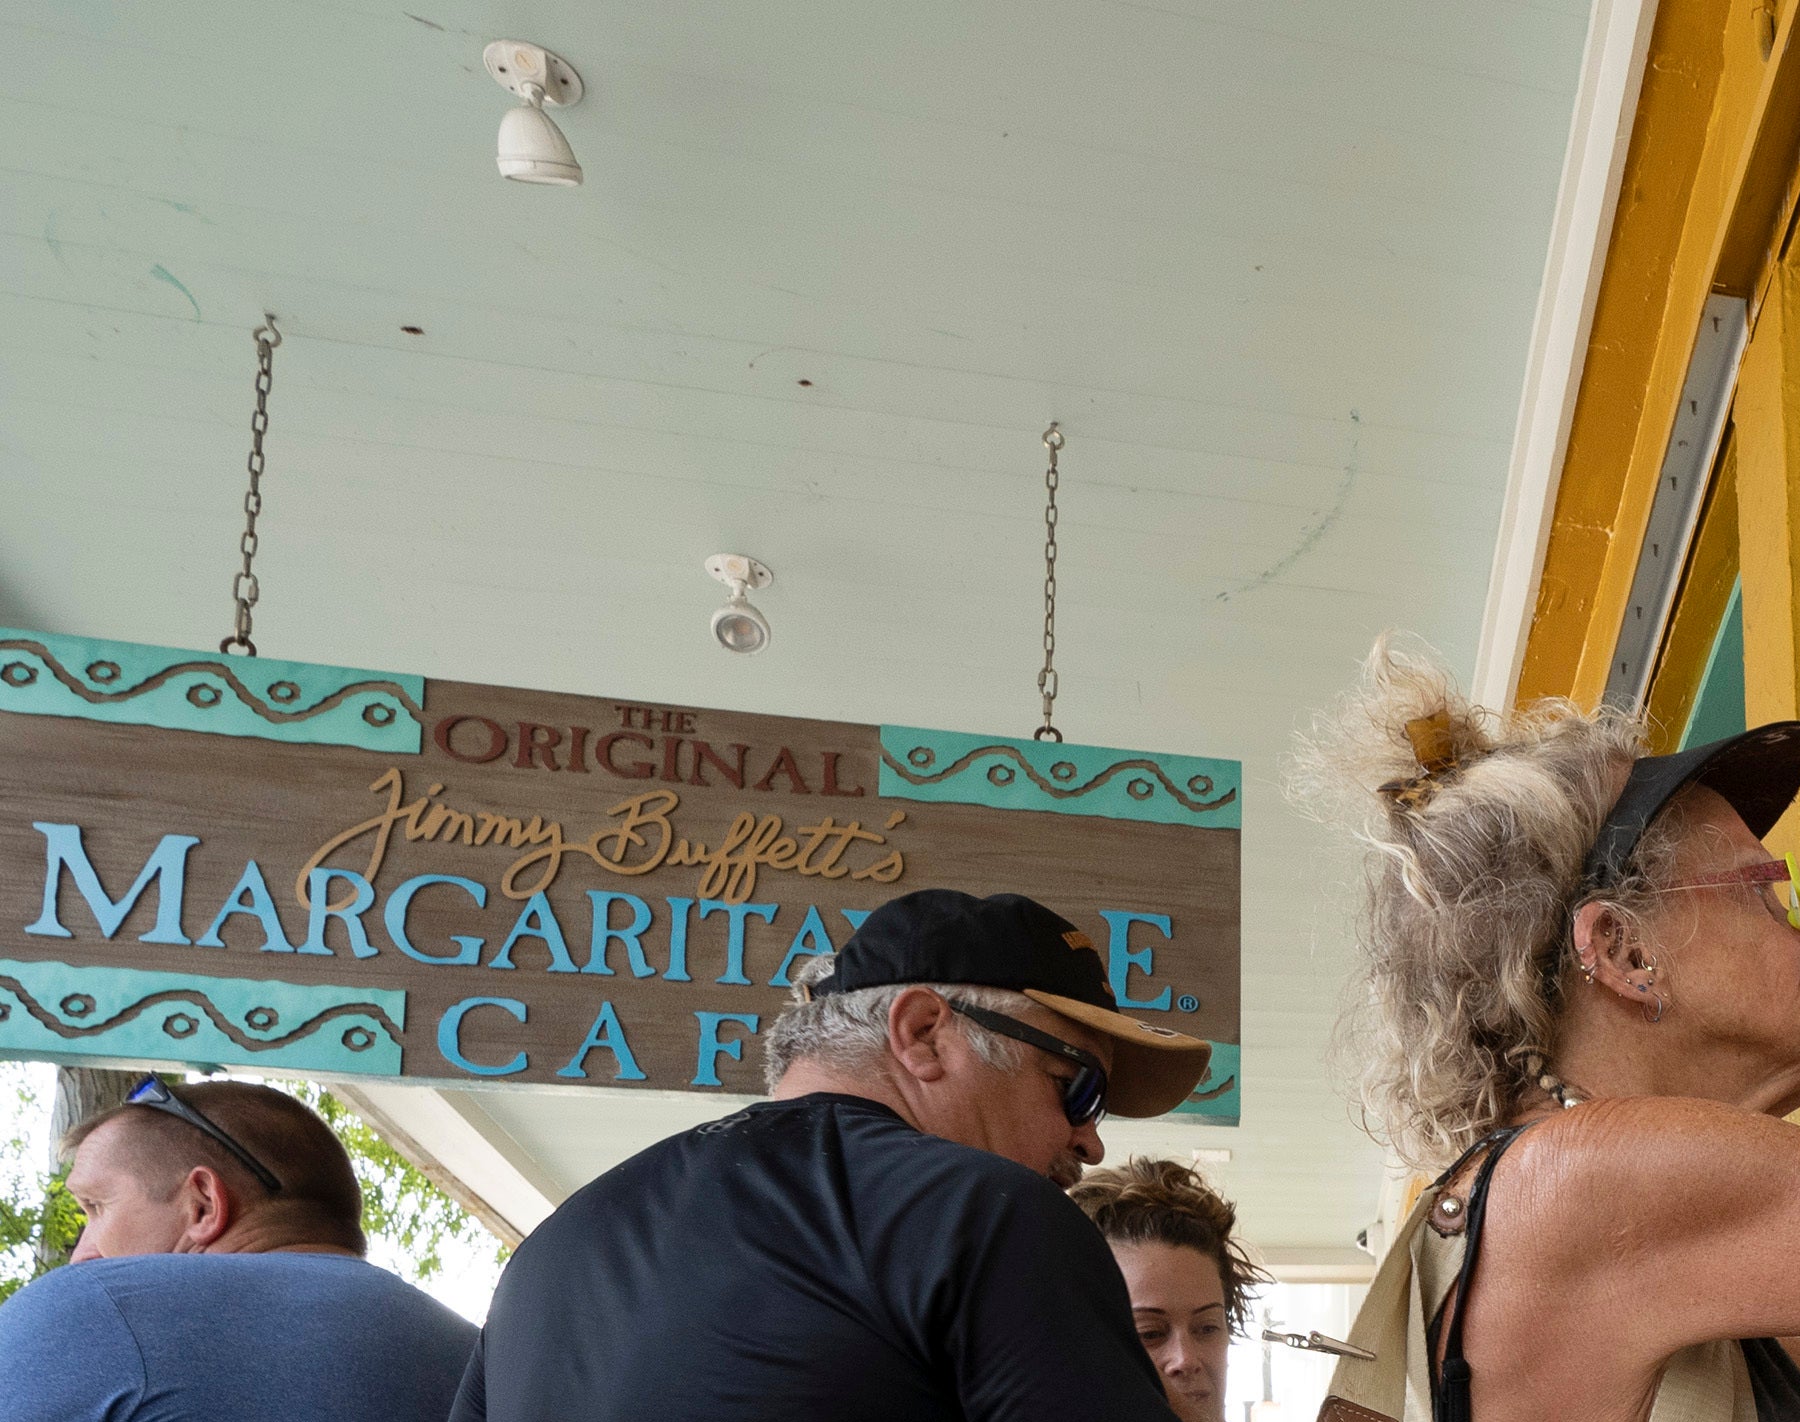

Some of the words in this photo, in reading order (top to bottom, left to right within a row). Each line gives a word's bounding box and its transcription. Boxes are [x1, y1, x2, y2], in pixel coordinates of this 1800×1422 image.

[433, 714, 865, 797] ORIGINAL
[614, 704, 698, 734] THE
[296, 768, 566, 912] Jimmy
[587, 788, 907, 904] Buffett's
[438, 995, 761, 1089] CAF
